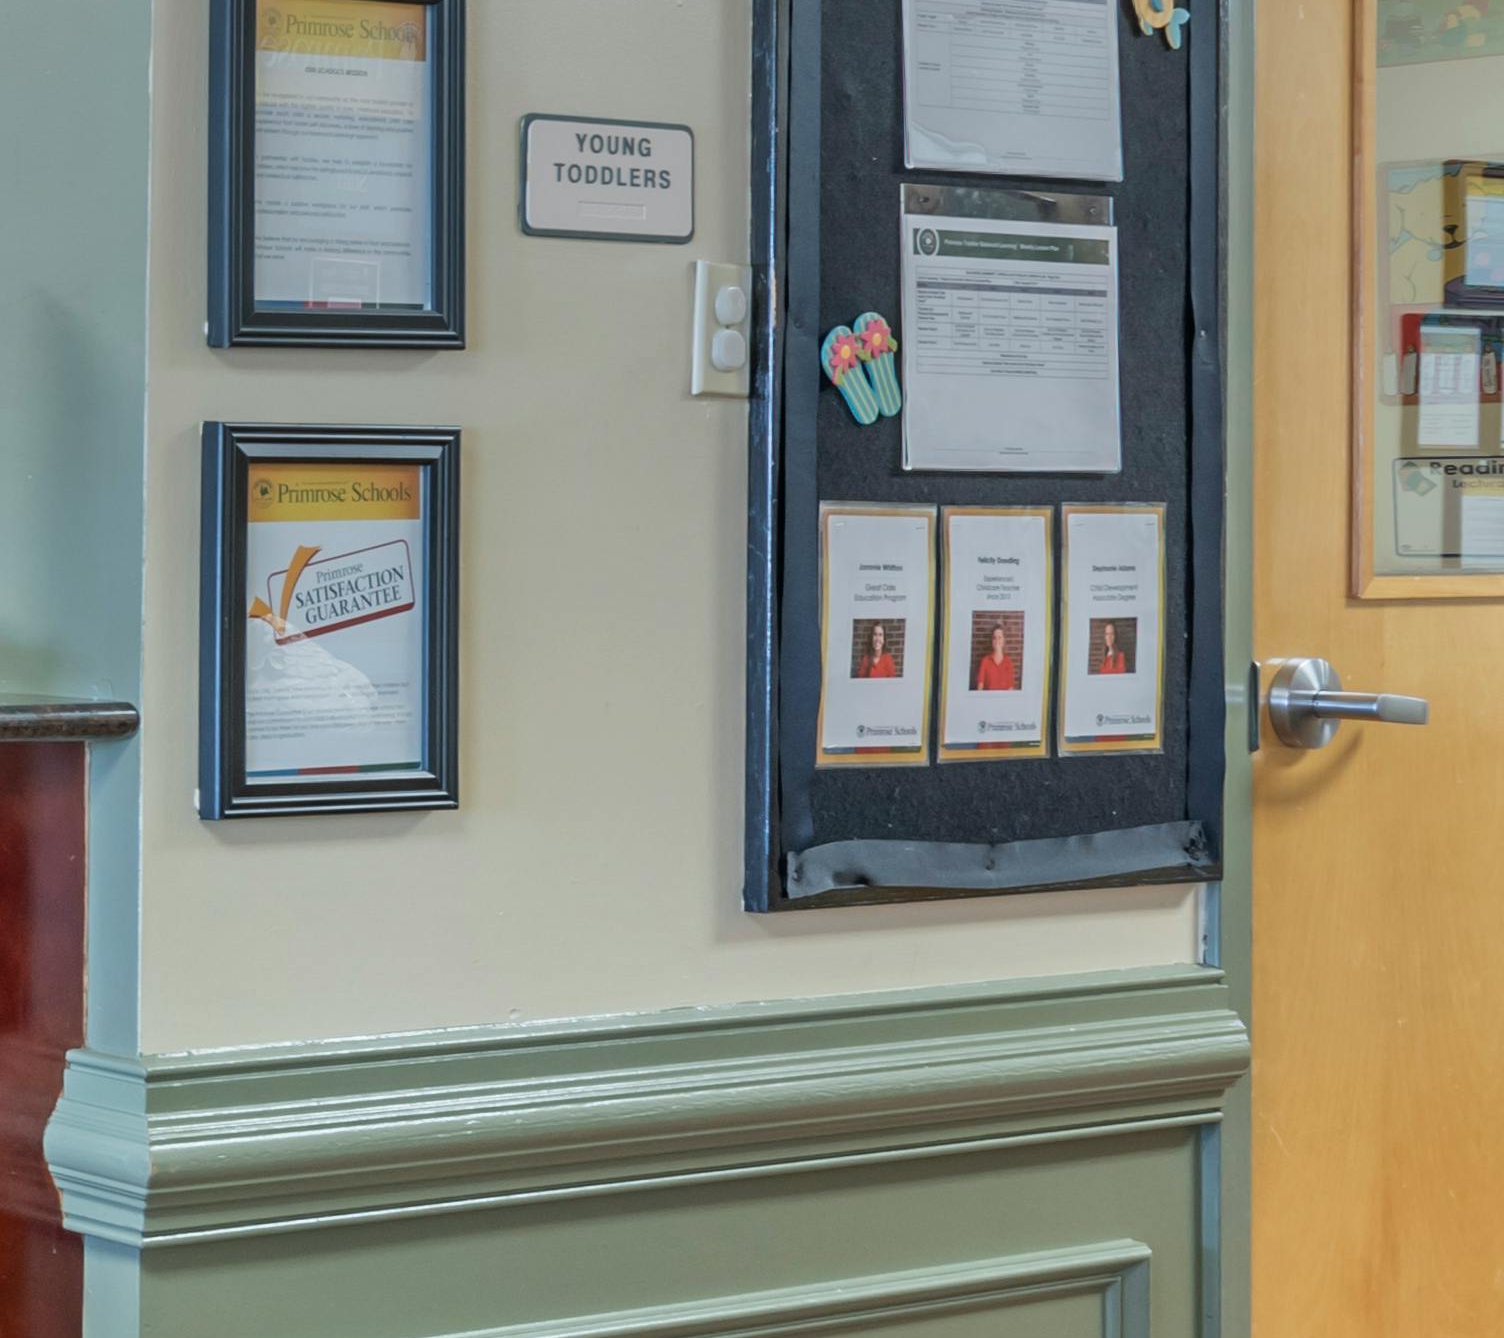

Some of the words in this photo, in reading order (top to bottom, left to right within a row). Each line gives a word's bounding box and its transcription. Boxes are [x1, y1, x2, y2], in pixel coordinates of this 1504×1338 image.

[285, 13, 355, 39] Primrose
[575, 133, 652, 158] YOUNG
[553, 162, 671, 190] TODDLERS
[277, 483, 347, 503] Primrose
[351, 481, 411, 503] Schools
[316, 562, 364, 584] Primrose
[295, 565, 405, 610] SATISFACTION
[305, 585, 402, 625] GUARANTEE
